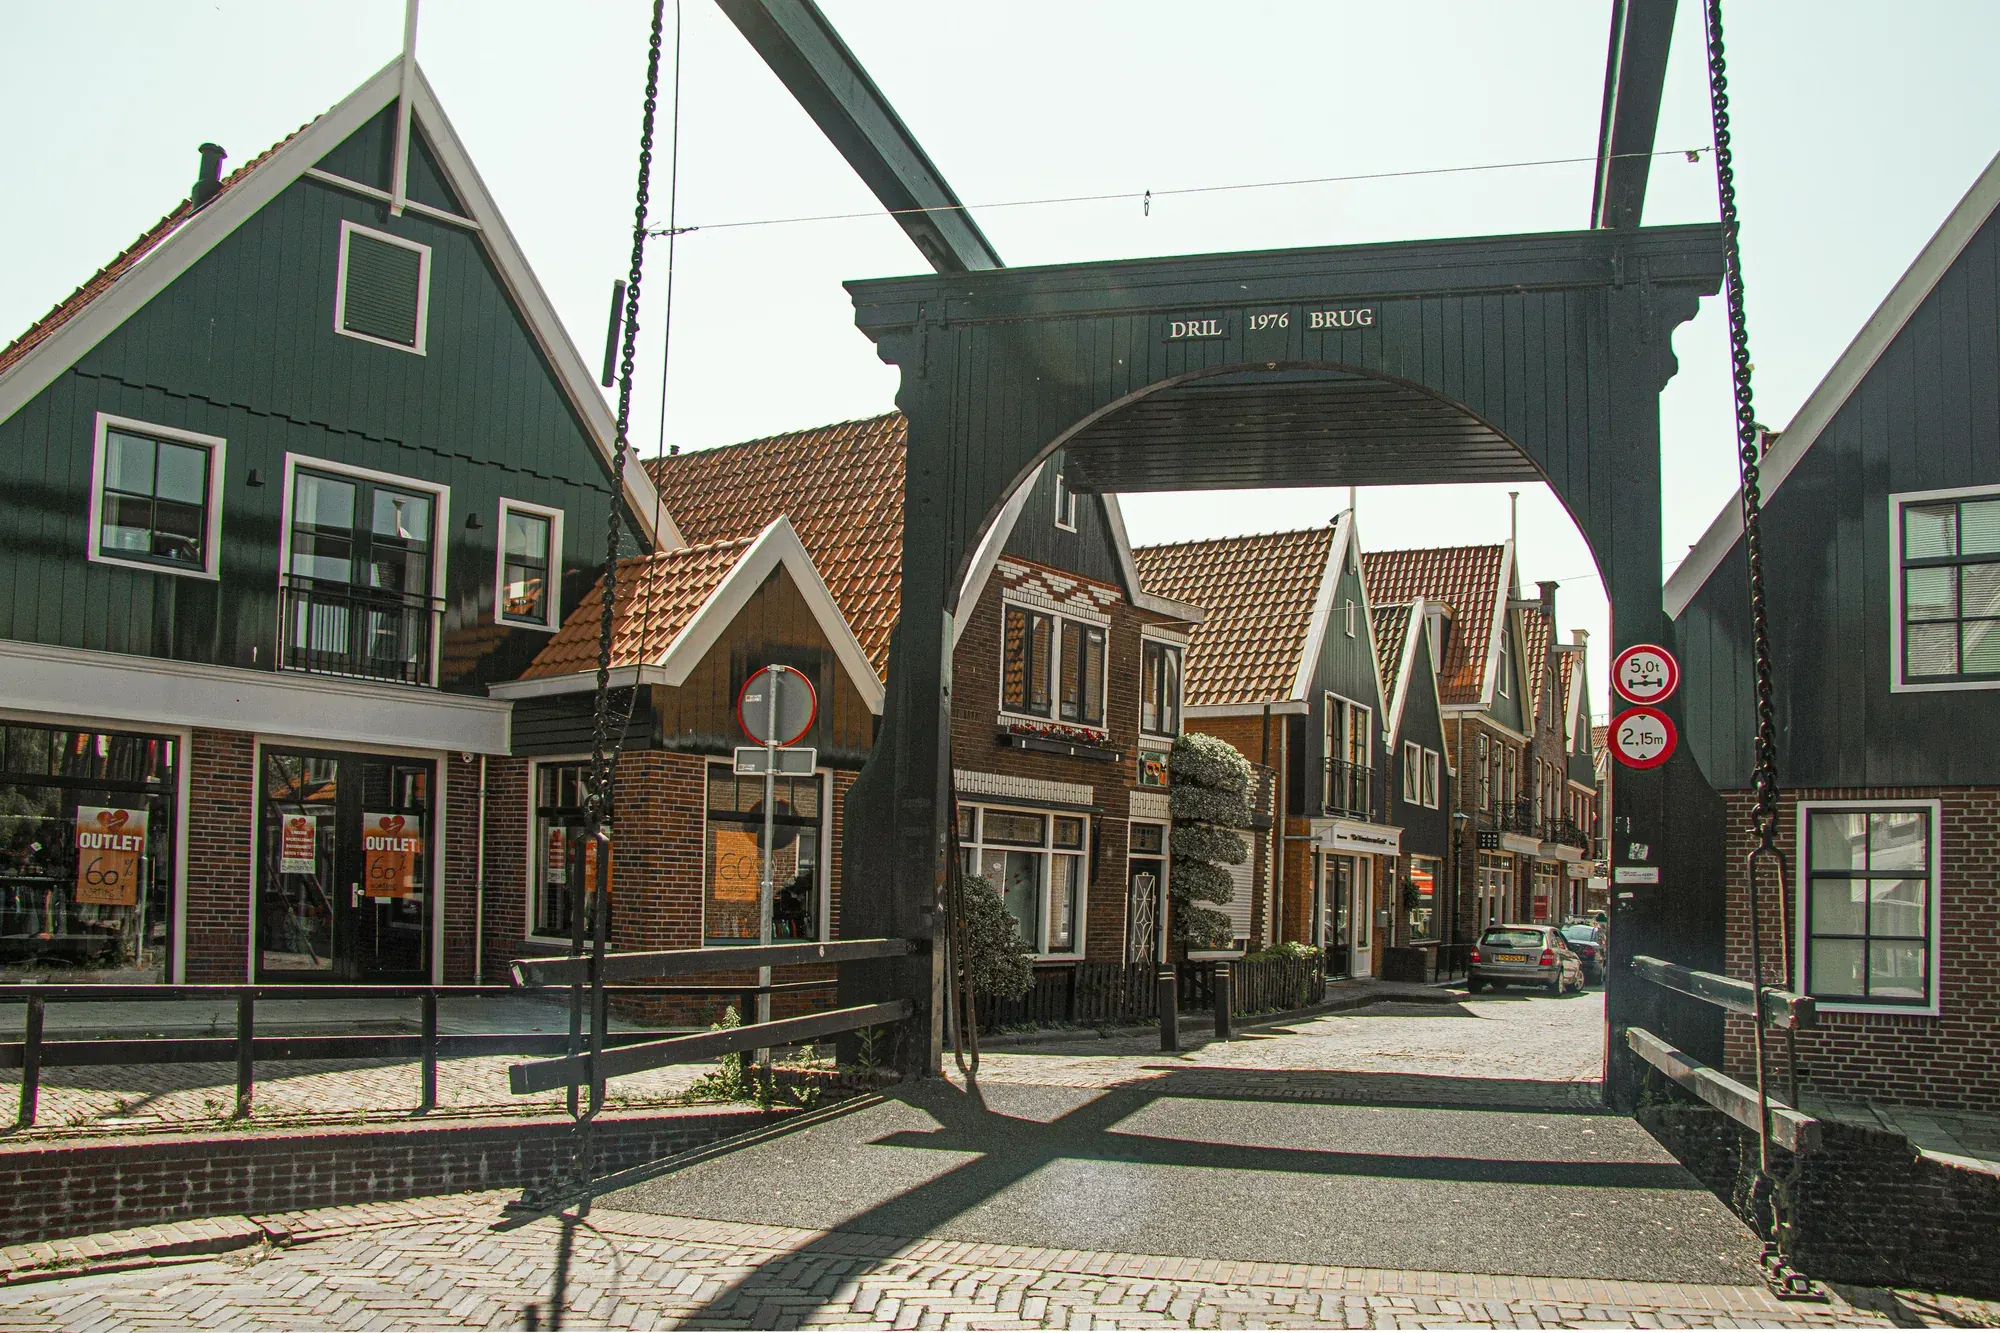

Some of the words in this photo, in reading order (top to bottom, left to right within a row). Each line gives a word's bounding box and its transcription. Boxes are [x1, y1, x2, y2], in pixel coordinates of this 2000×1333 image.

[1170, 319, 1223, 338] DRIL
[1249, 312, 1290, 331] 1976
[1309, 308, 1374, 329] BRUG
[79, 832, 142, 851] OUTLET
[366, 836, 417, 852] OUTLET
